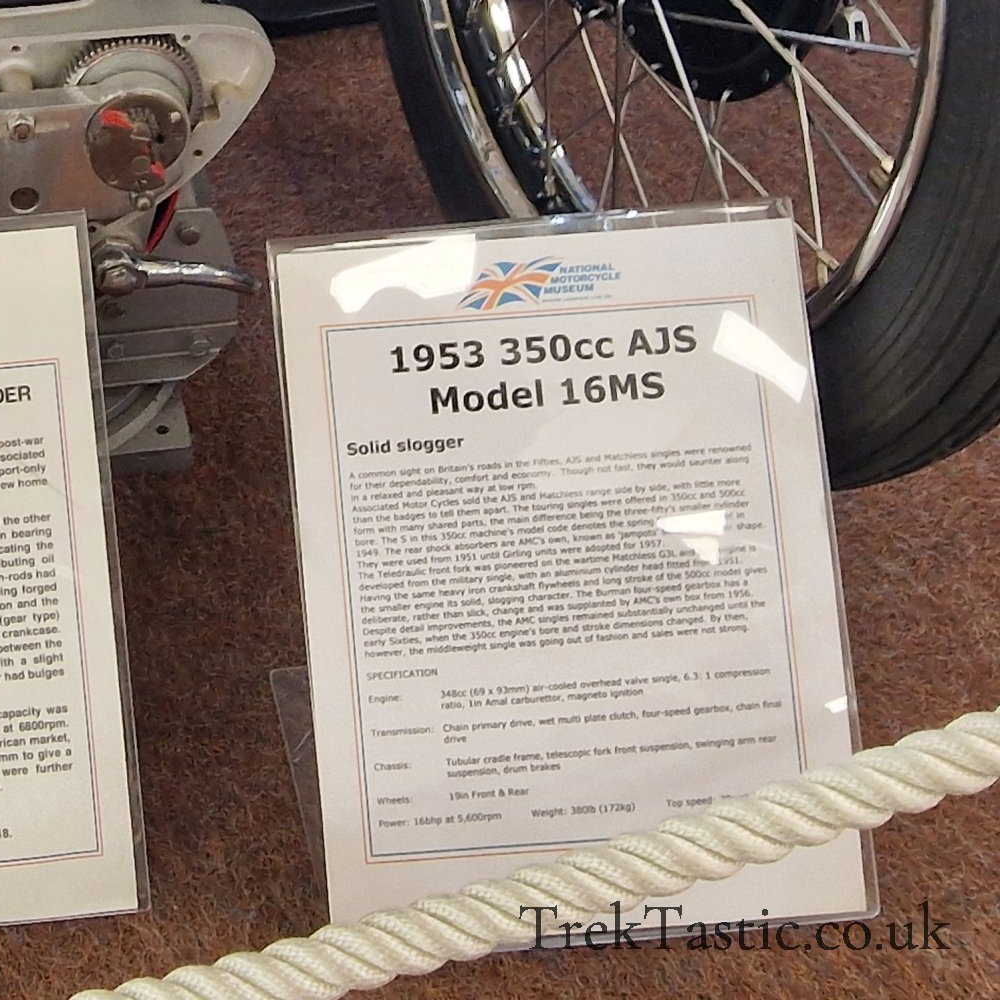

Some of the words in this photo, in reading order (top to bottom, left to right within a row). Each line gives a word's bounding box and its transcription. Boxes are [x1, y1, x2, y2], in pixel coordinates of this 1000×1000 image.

[559, 263, 615, 274] NATIONAL
[551, 272, 621, 284] MOTORCYCLE
[543, 284, 594, 295] MUSEUM
[390, 340, 484, 373] 1953
[500, 334, 614, 365] 350cc
[628, 325, 696, 356] AJS
[430, 379, 543, 414] Model
[561, 371, 664, 405] 16MS
[346, 439, 391, 456] Solid
[396, 437, 464, 454] slogger
[17, 477, 48, 488] home
[366, 667, 438, 681] SPECIFICATION
[579, 677, 622, 689] overhead
[624, 676, 649, 685] valve
[713, 668, 771, 679] compression
[368, 694, 402, 704] Engine:
[370, 726, 434, 737] Transmission:
[29, 732, 70, 745] market,
[373, 762, 411, 772] Chassis:
[471, 789, 496, 799] Front
[507, 787, 529, 796] Rear
[376, 795, 413, 805] Wheels:
